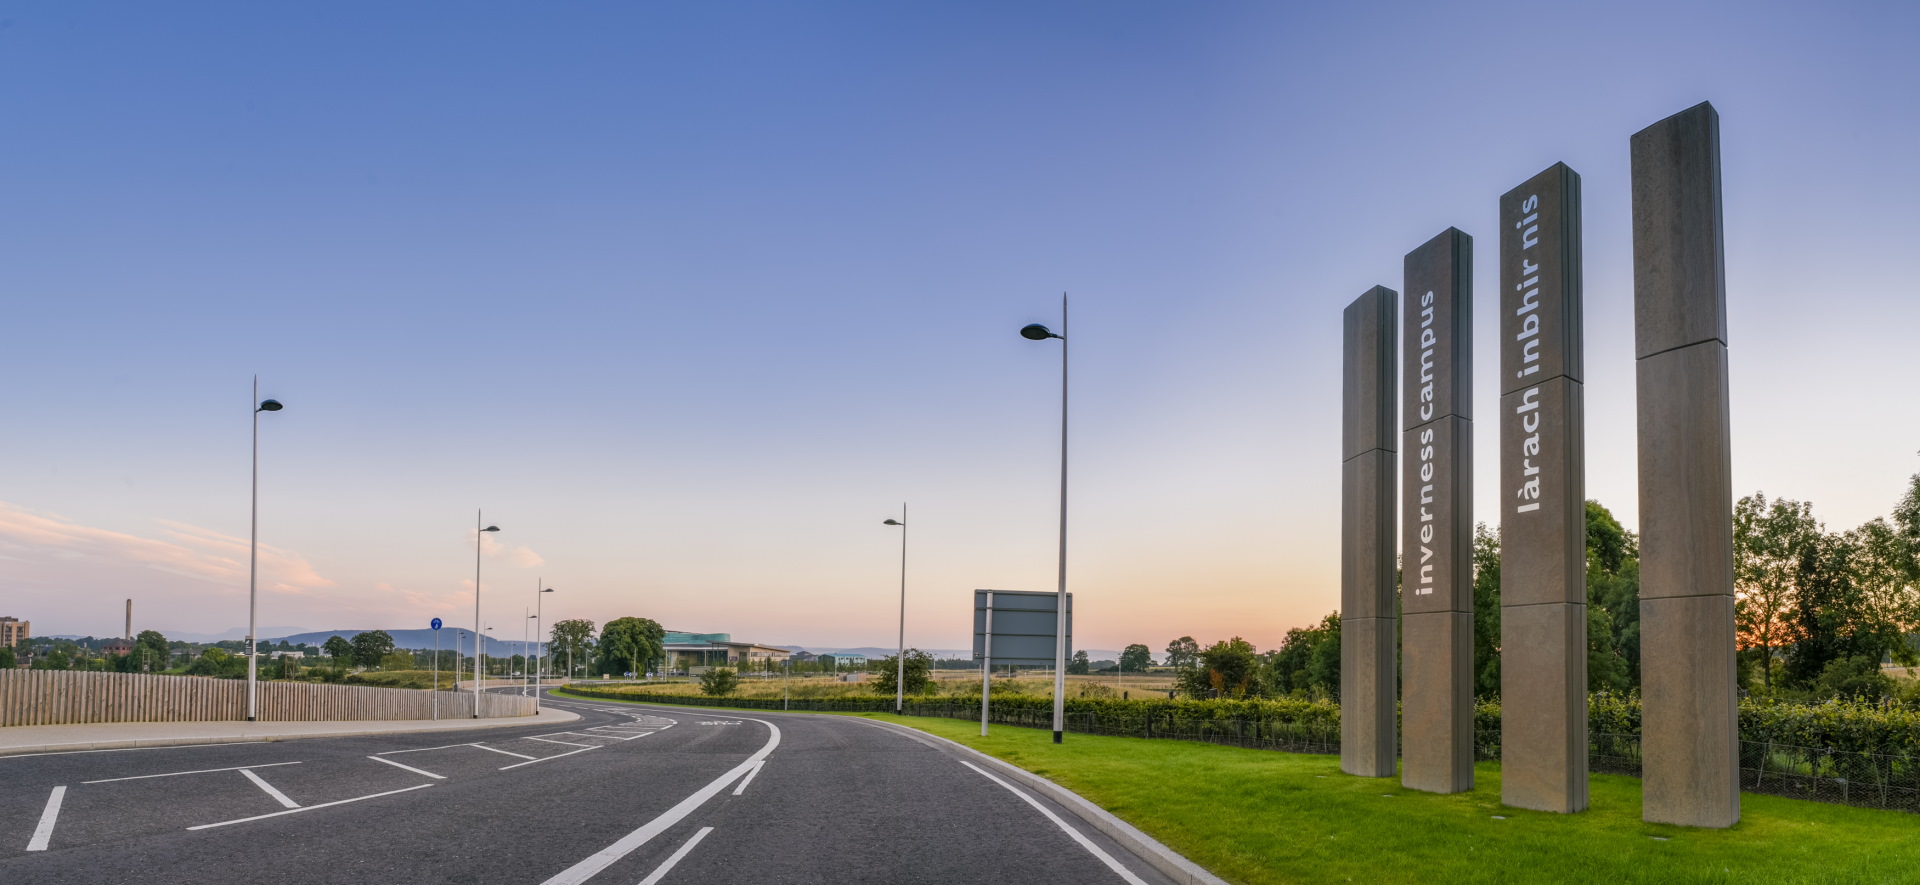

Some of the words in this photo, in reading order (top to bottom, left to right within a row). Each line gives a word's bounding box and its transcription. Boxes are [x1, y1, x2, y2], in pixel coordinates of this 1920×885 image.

[1516, 193, 1538, 251] nis
[1420, 290, 1435, 422] campus
[1517, 259, 1539, 379] inbhir
[1415, 428, 1434, 596] inverness
[1517, 386, 1540, 513] làrach
